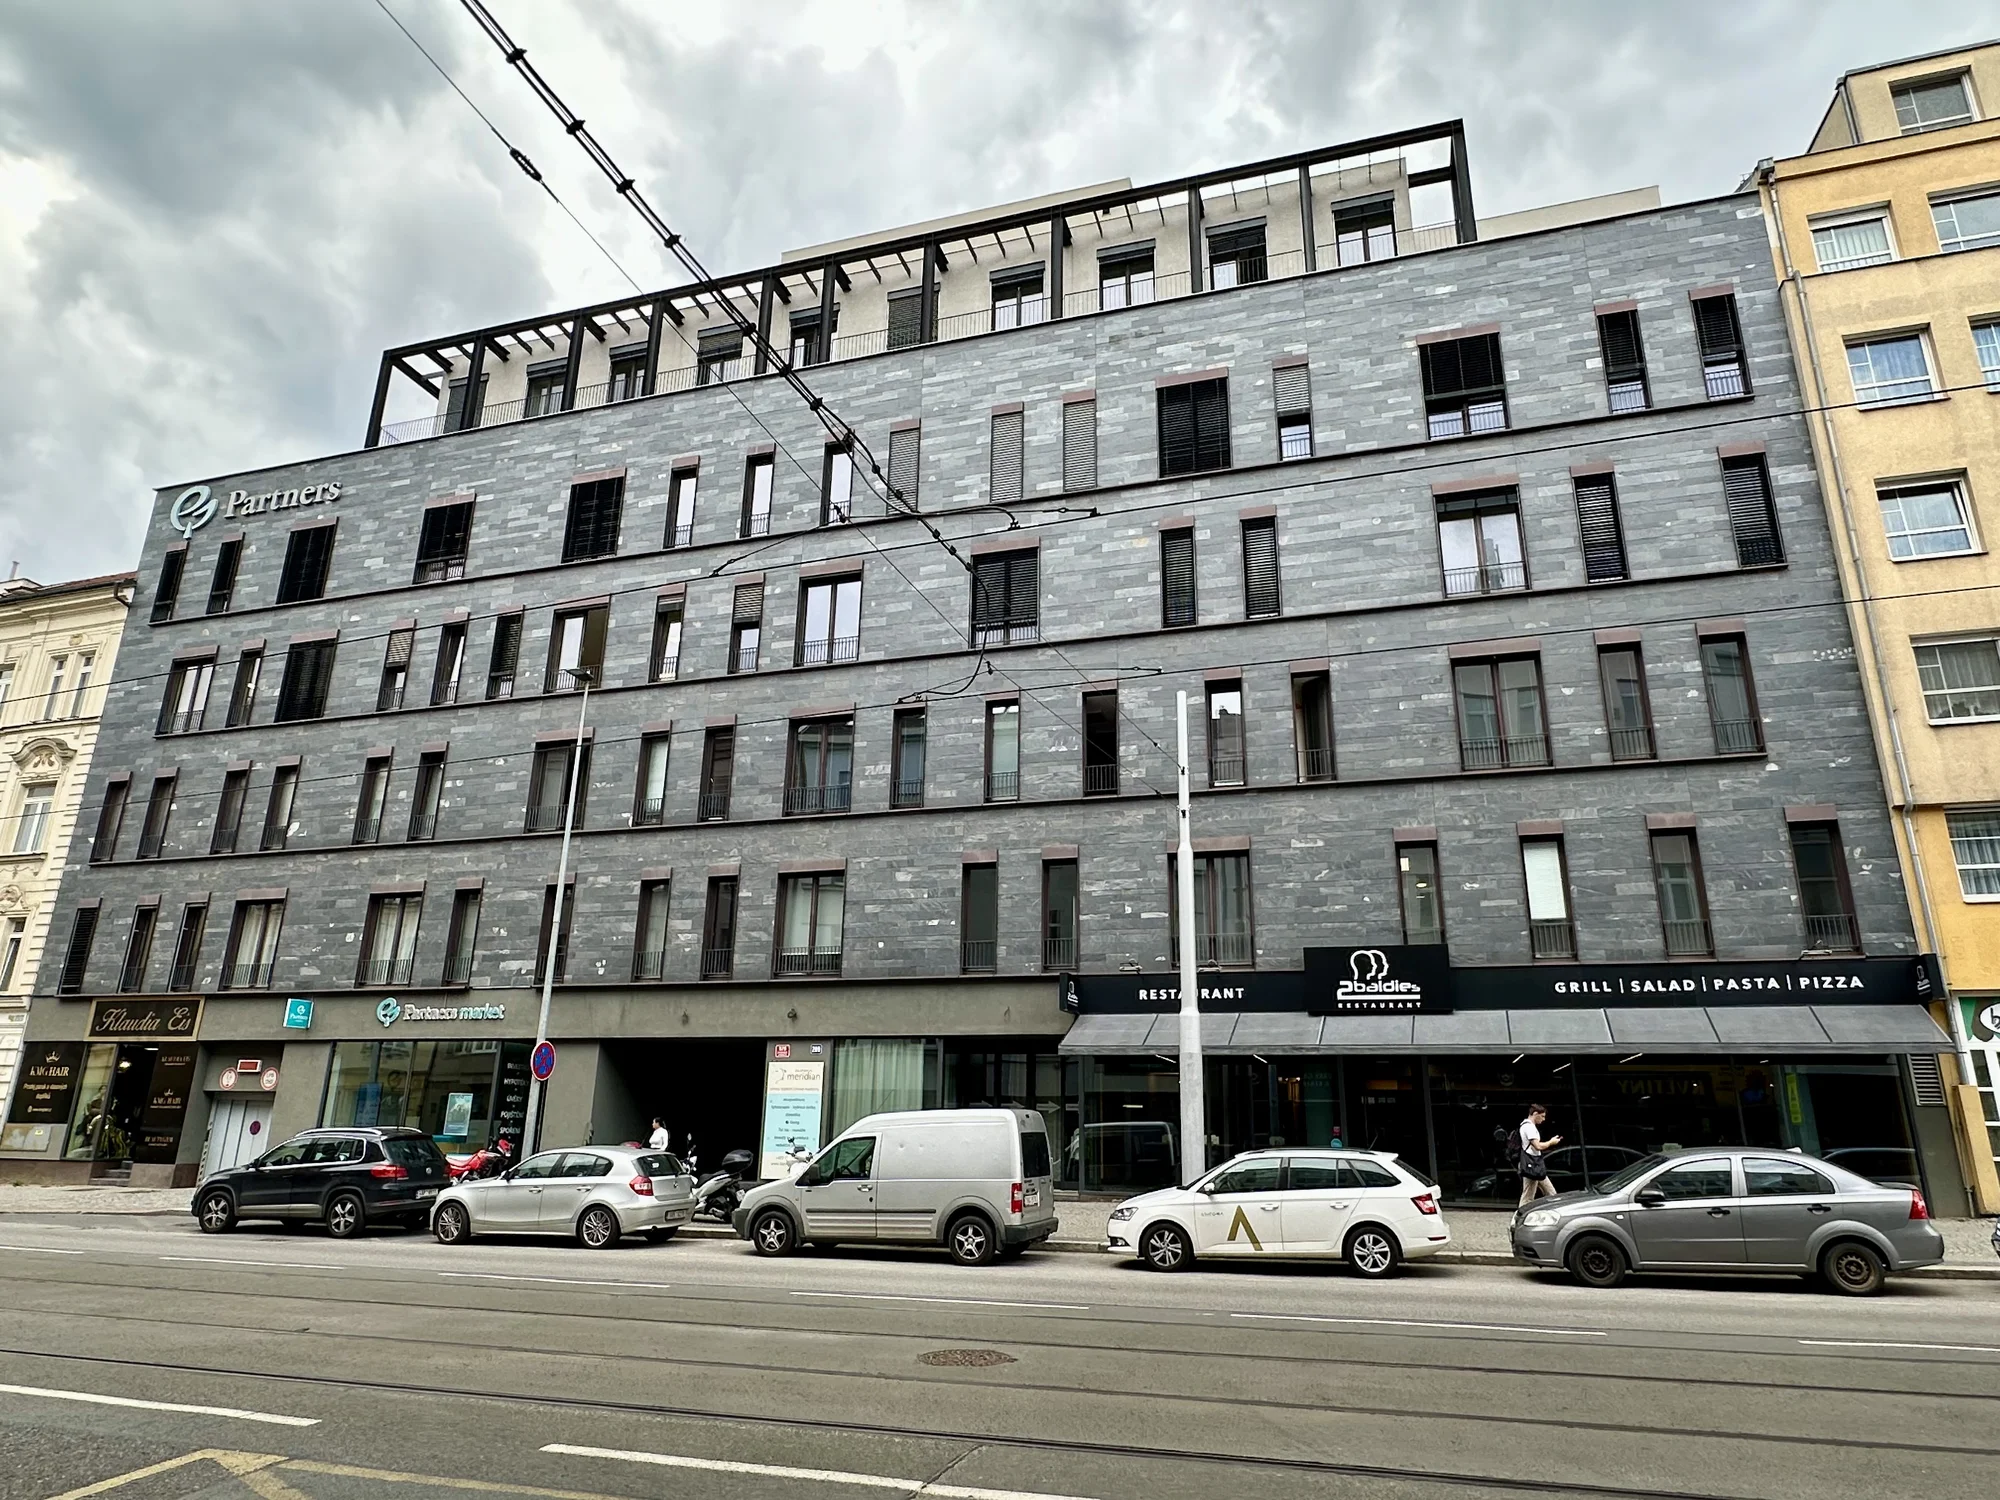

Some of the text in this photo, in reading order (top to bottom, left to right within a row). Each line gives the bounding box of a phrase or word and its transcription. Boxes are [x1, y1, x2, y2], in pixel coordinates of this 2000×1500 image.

[224, 481, 342, 518] Partners
[1139, 987, 1245, 1001] RESTRANT
[1337, 980, 1421, 1000] 2baldies
[1554, 976, 1865, 994] GRILL SALAD PASTA PIZZA
[95, 1007, 192, 1032] Klaudia Eis
[402, 1002, 506, 1020] Partners market
[48, 1066, 70, 1077] HAIR
[787, 1070, 821, 1080] meridian
